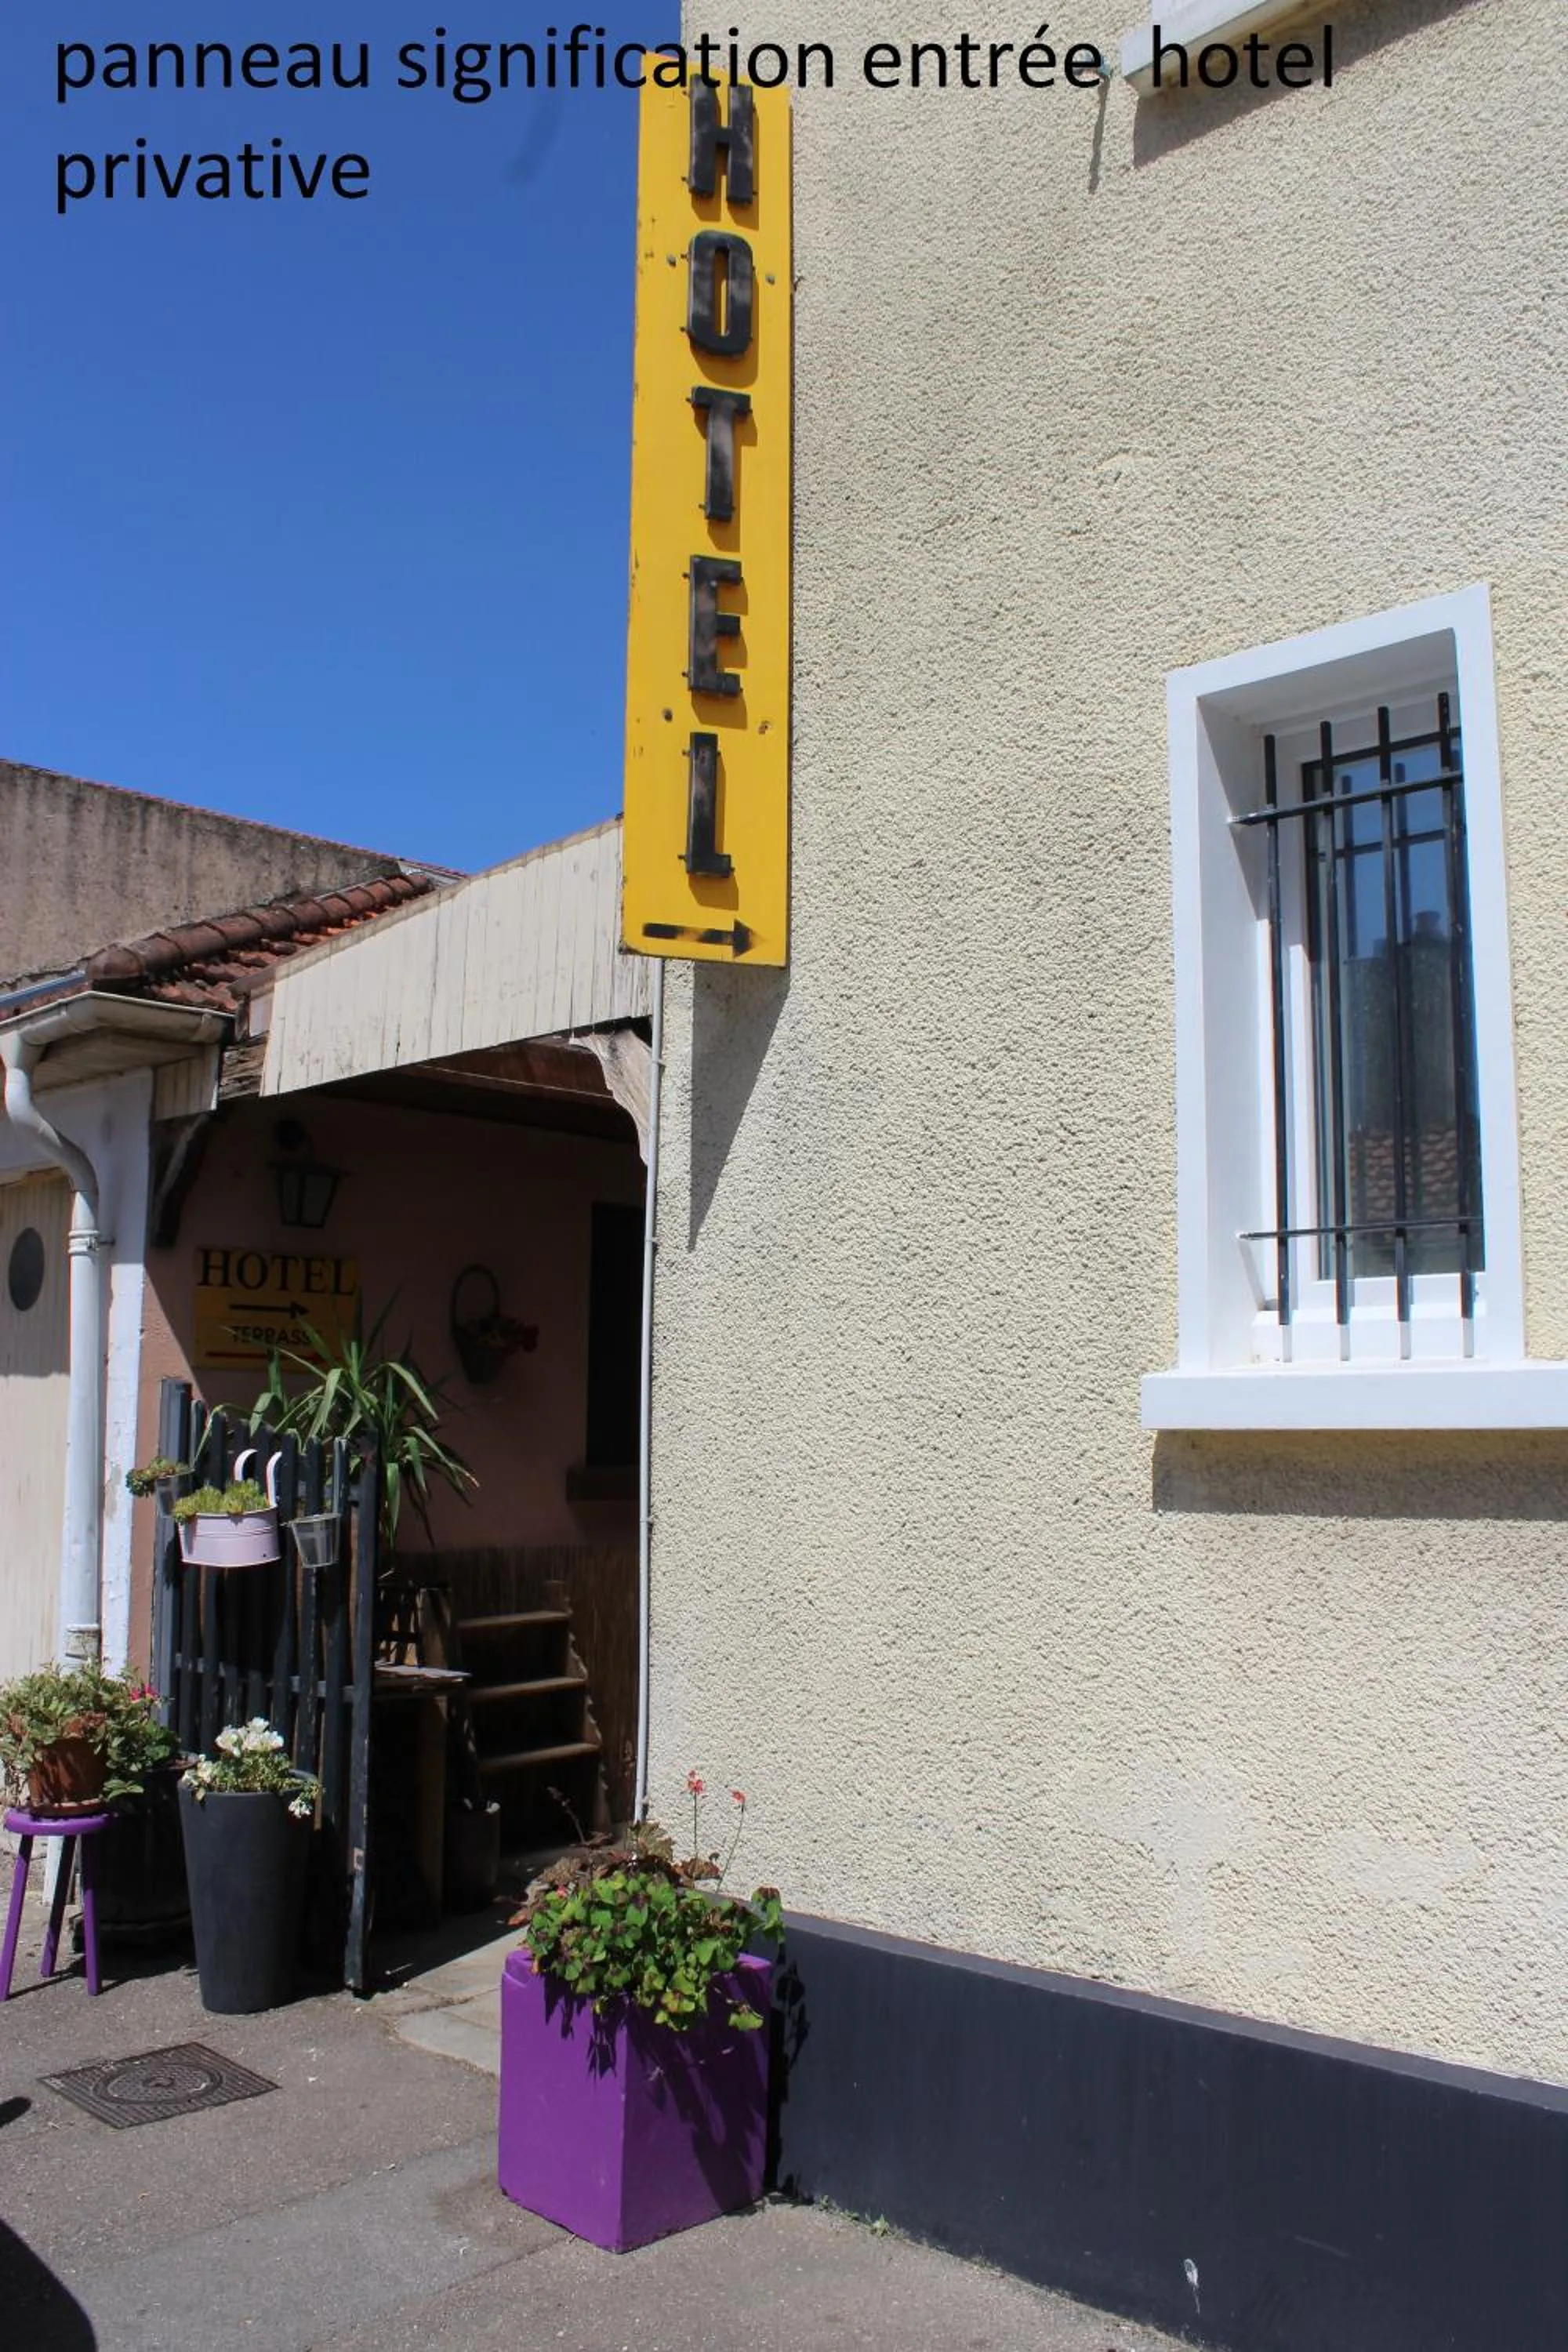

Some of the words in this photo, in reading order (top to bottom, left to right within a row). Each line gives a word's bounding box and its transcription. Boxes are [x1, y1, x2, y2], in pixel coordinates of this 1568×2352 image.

[685, 74, 753, 877] HOTEL
[197, 1249, 356, 1296] HOTEL
[231, 1326, 322, 1345] TERRASS
